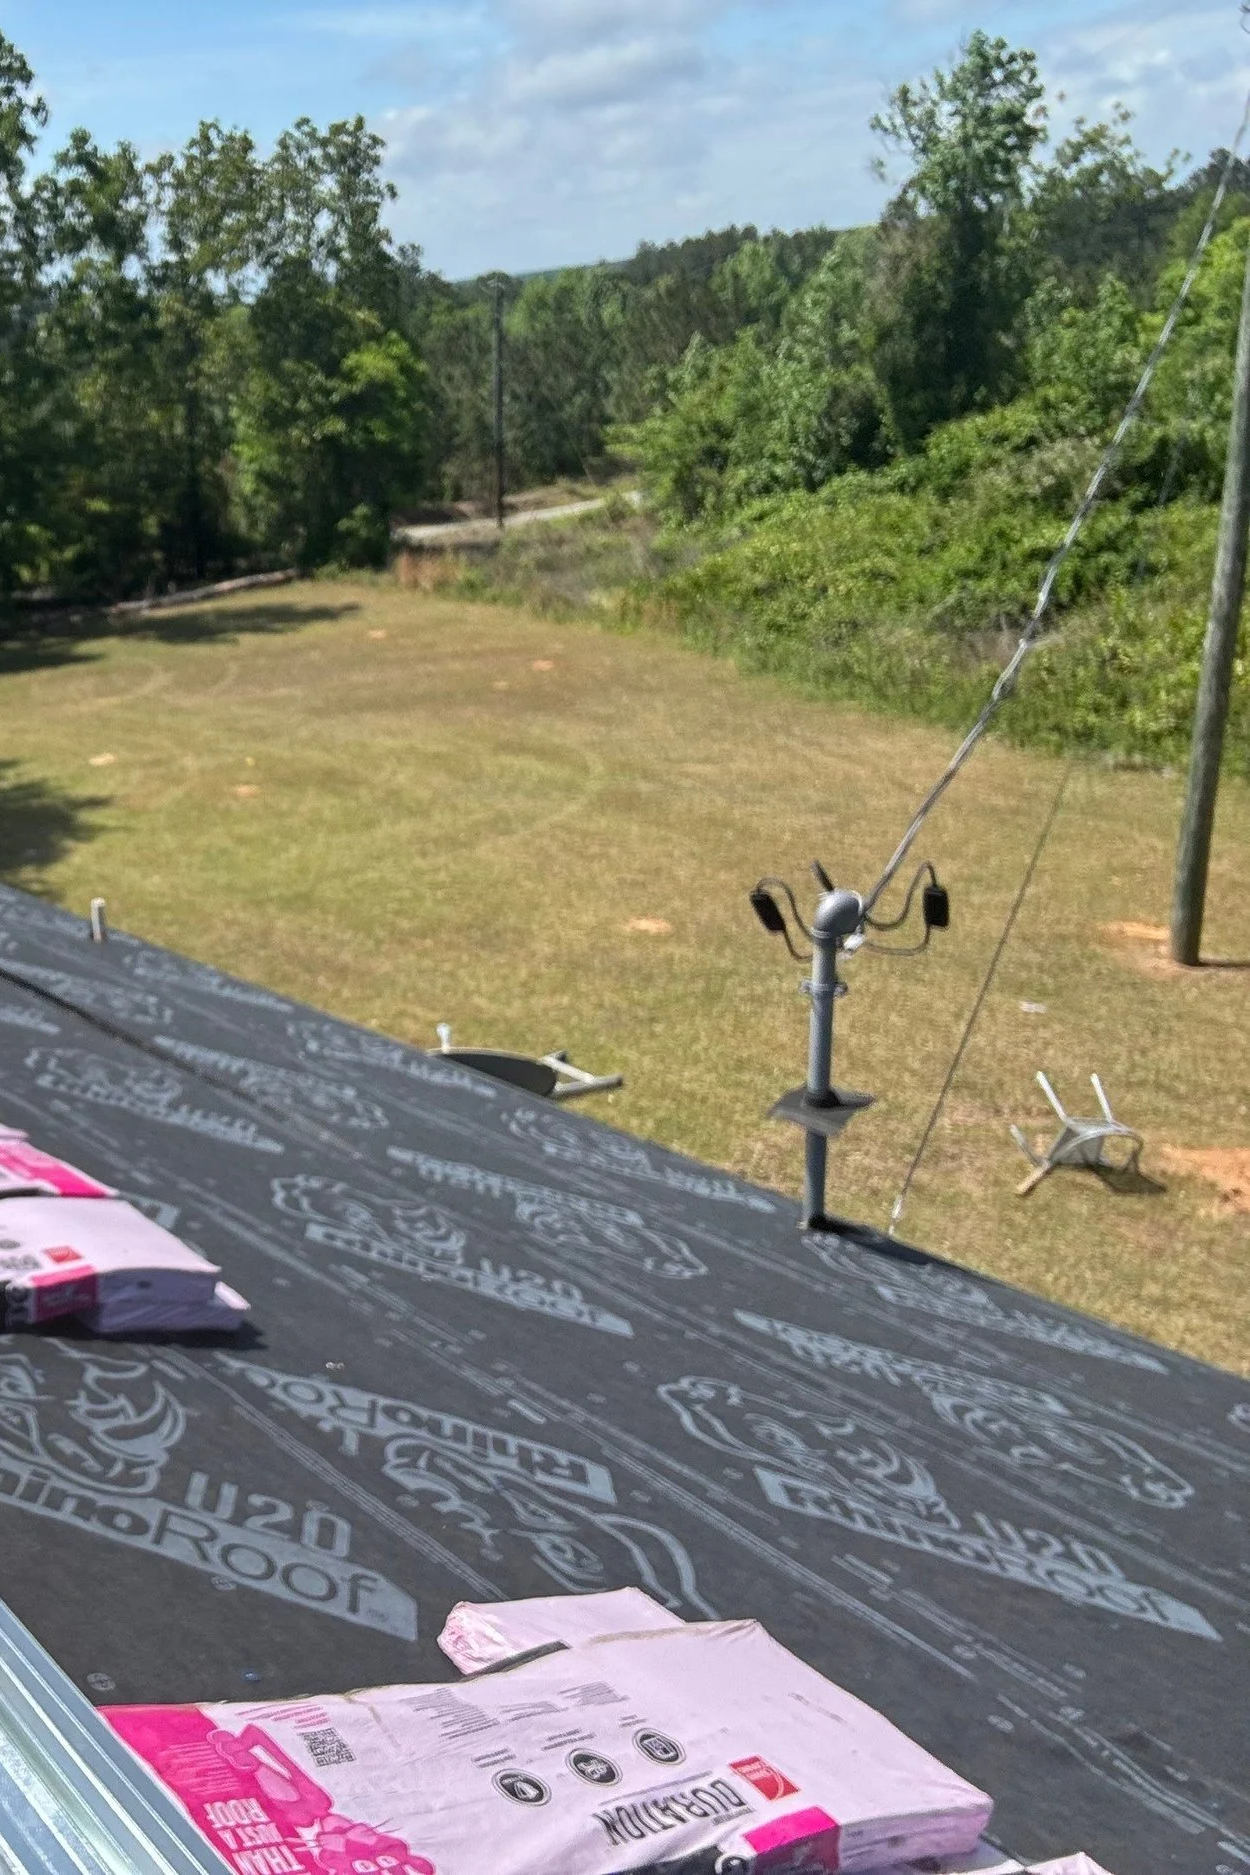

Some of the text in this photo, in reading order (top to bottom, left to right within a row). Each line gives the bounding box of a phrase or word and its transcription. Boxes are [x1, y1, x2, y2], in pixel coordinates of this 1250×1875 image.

[184, 1471, 352, 1560] U20
[972, 1510, 1127, 1584] U20
[203, 1797, 270, 1829] ROOF
[217, 1828, 238, 1850] A
[592, 1778, 748, 1846] DURATION
